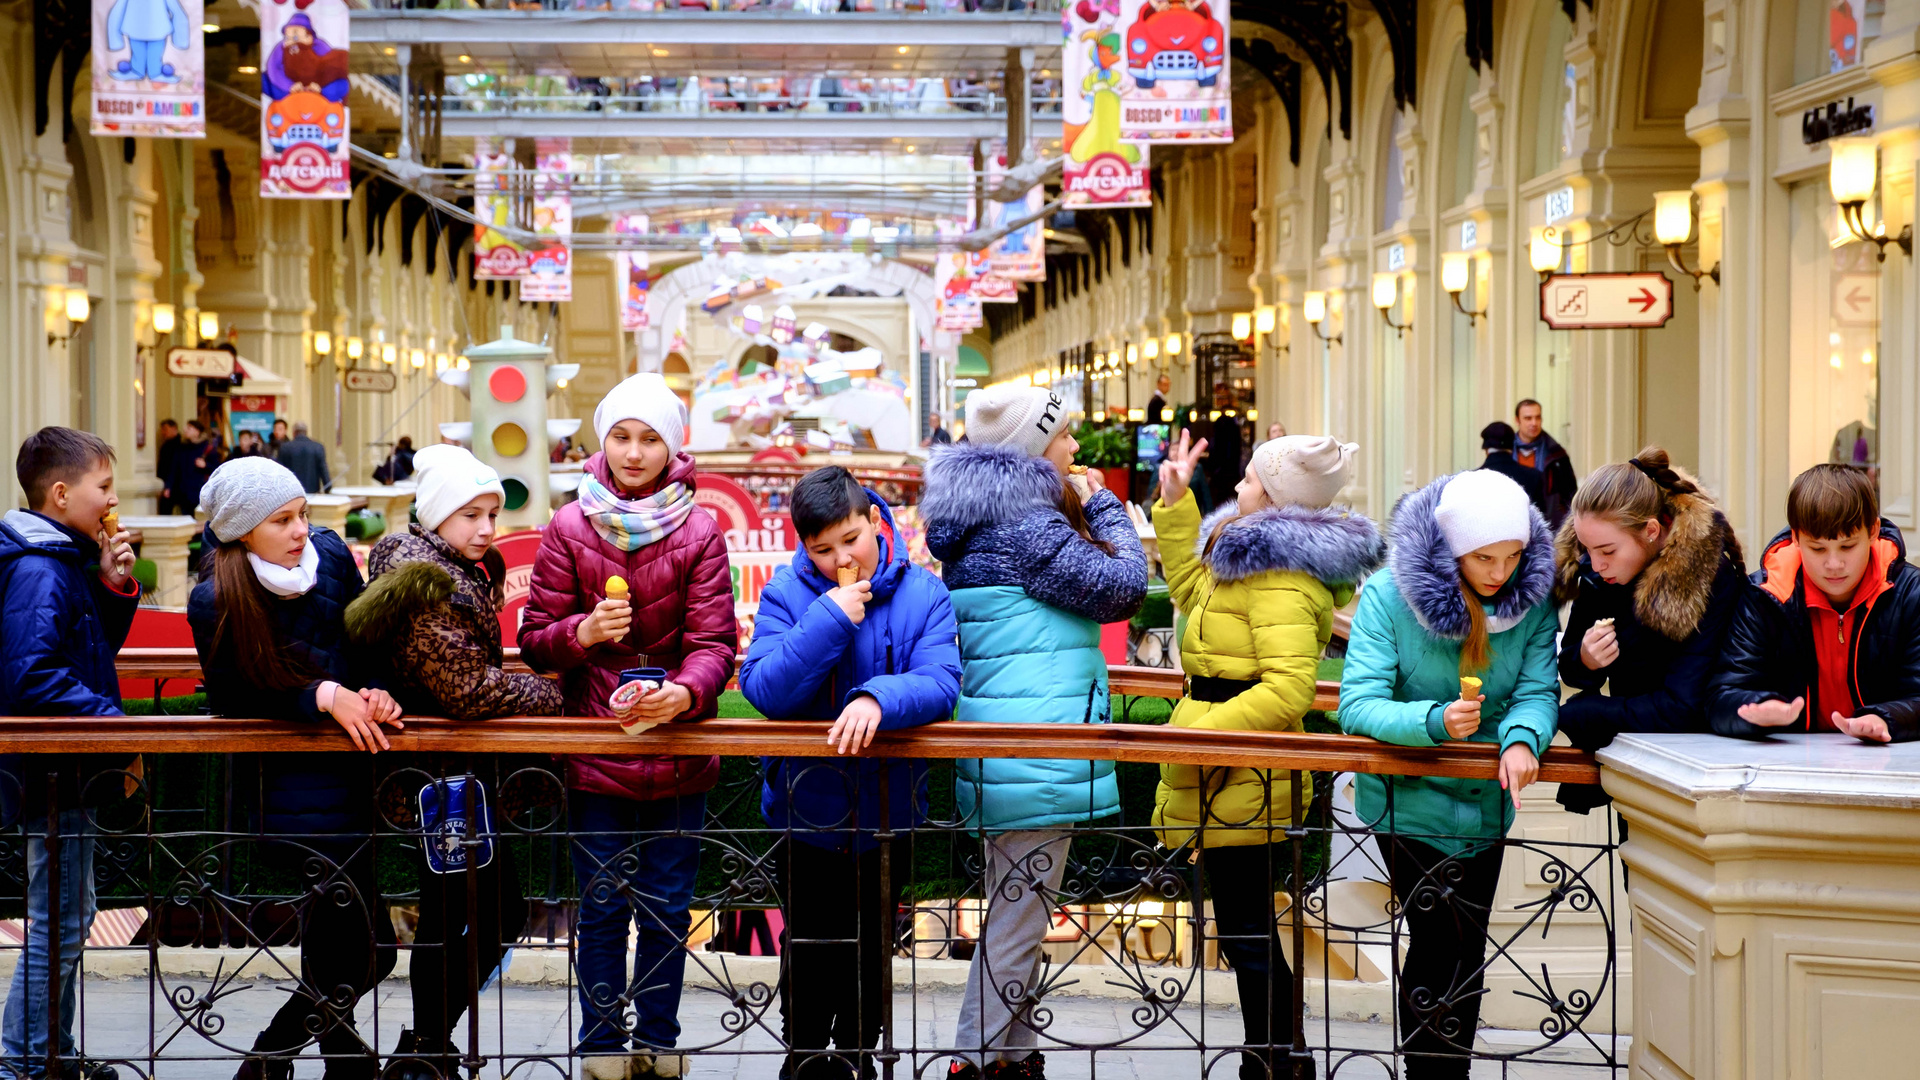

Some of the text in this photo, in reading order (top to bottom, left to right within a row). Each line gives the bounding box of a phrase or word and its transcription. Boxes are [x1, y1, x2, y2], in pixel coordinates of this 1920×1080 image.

[98, 99, 133, 115] BOSCO
[146, 100, 200, 116] BAMBINO
[1125, 108, 1162, 123] BOSCO
[1174, 106, 1226, 123] BAMBINO
